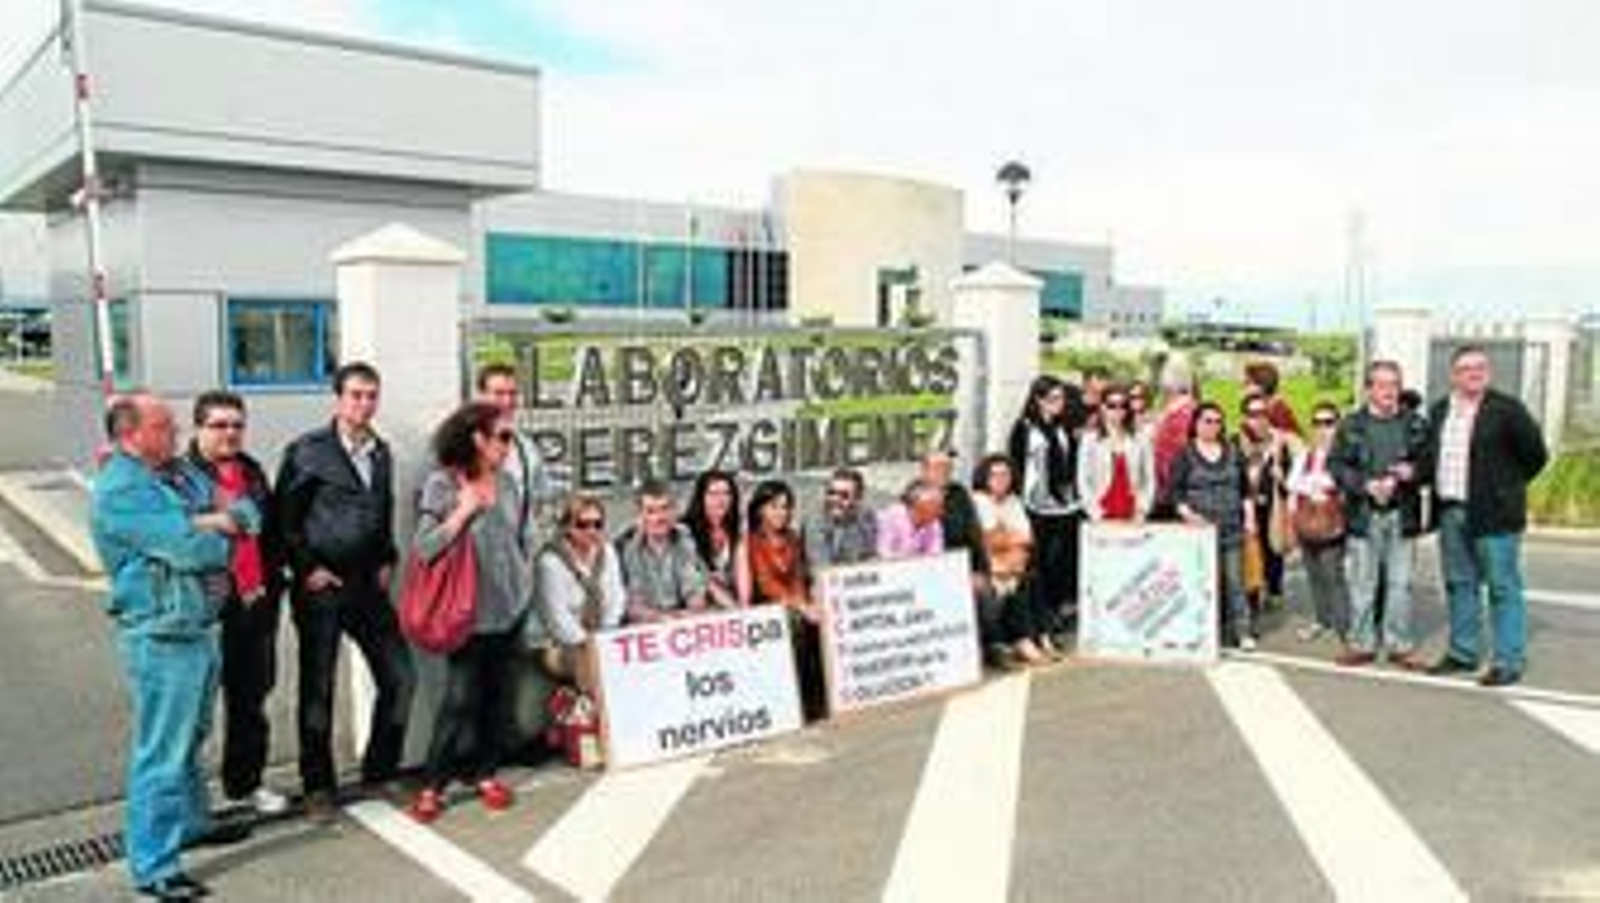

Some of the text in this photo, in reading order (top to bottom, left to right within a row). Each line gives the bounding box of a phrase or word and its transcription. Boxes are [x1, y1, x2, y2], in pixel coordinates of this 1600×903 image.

[530, 343, 959, 409] LABORATORIOS
[612, 618, 783, 665] TE CRISpa
[685, 670, 735, 698] los
[657, 703, 772, 750] nervios
